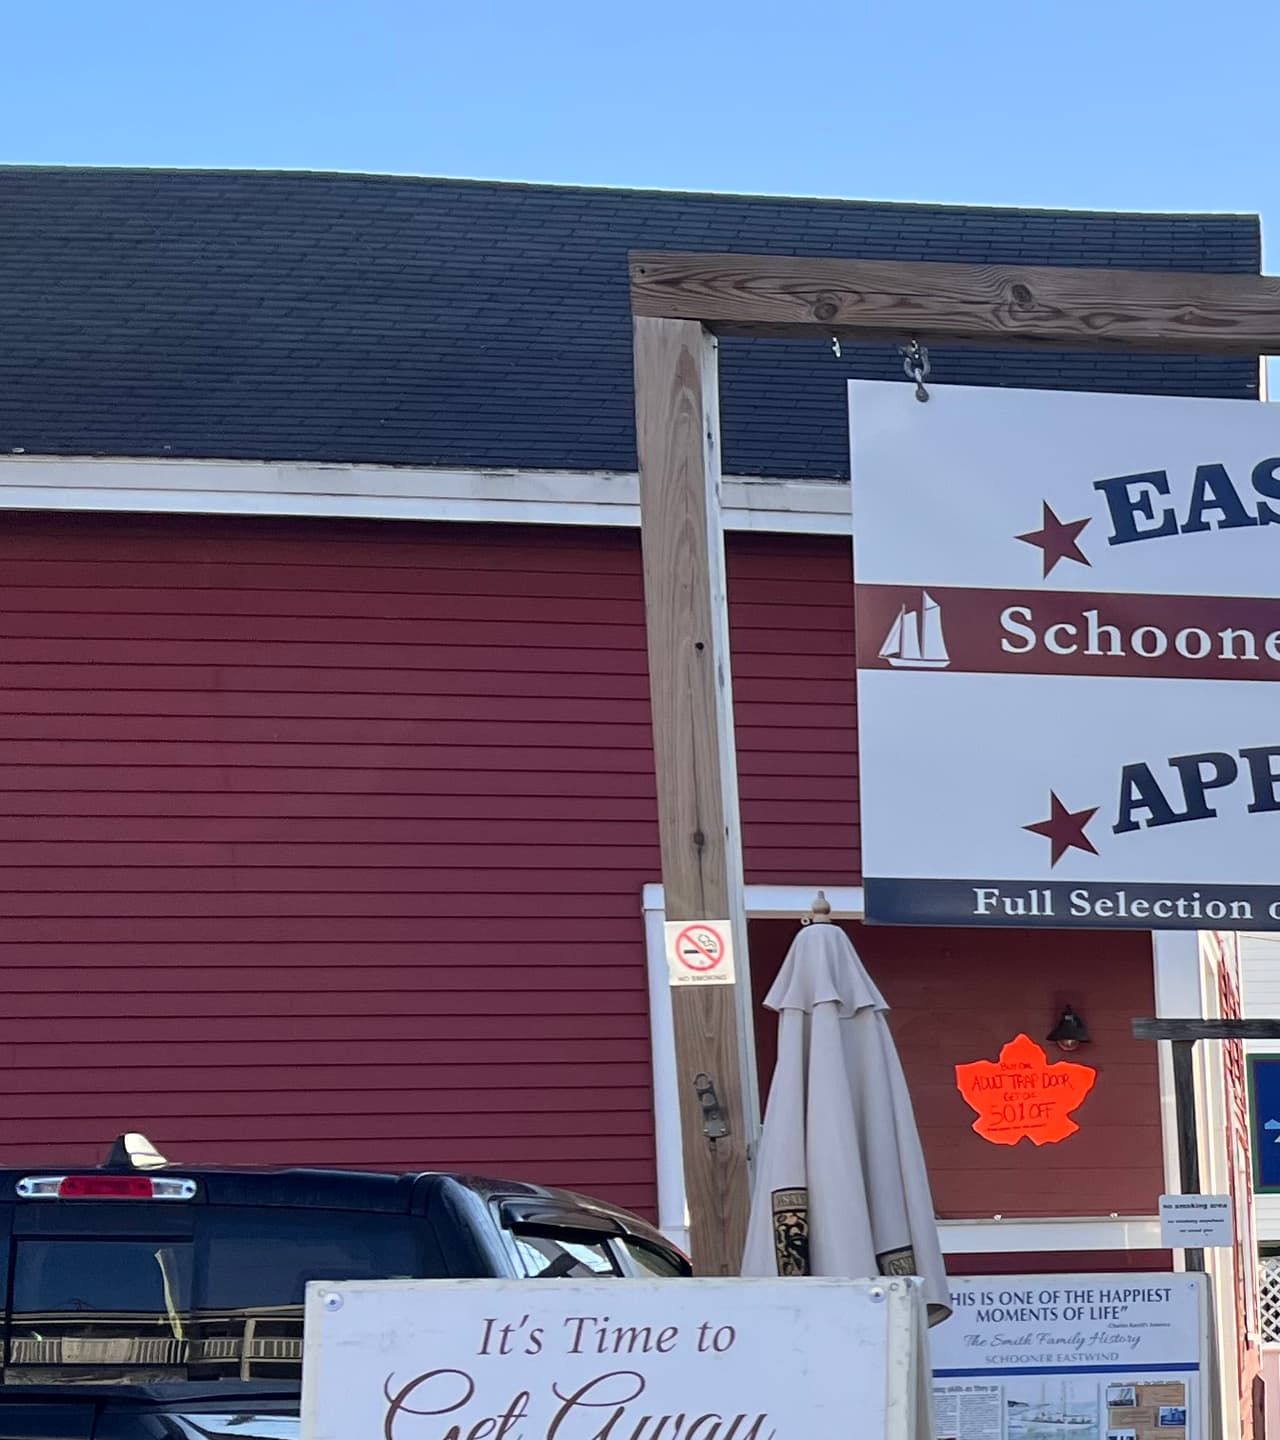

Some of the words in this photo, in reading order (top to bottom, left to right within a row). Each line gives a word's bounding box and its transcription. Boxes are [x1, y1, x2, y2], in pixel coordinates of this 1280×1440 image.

[972, 888, 1056, 917] Full
[1069, 889, 1254, 920] Selection
[949, 1292, 976, 1307] HIS
[980, 1292, 995, 1306] IS
[999, 1290, 1034, 1306] ONE
[1038, 1289, 1061, 1305] OF
[1063, 1289, 1095, 1304] THE
[1099, 1288, 1172, 1303] HAPPIEST
[975, 1307, 1059, 1323] MOMENTS
[1062, 1306, 1085, 1321] OF
[478, 1314, 545, 1356] It's
[563, 1316, 677, 1355] Time
[698, 1318, 736, 1352] to
[963, 1333, 988, 1349] The
[989, 1332, 1034, 1348] Smith
[1035, 1332, 1086, 1351] Family
[1086, 1331, 1142, 1351] History
[984, 1353, 1054, 1365] SCHOONER
[1056, 1351, 1120, 1363] EASTWIND
